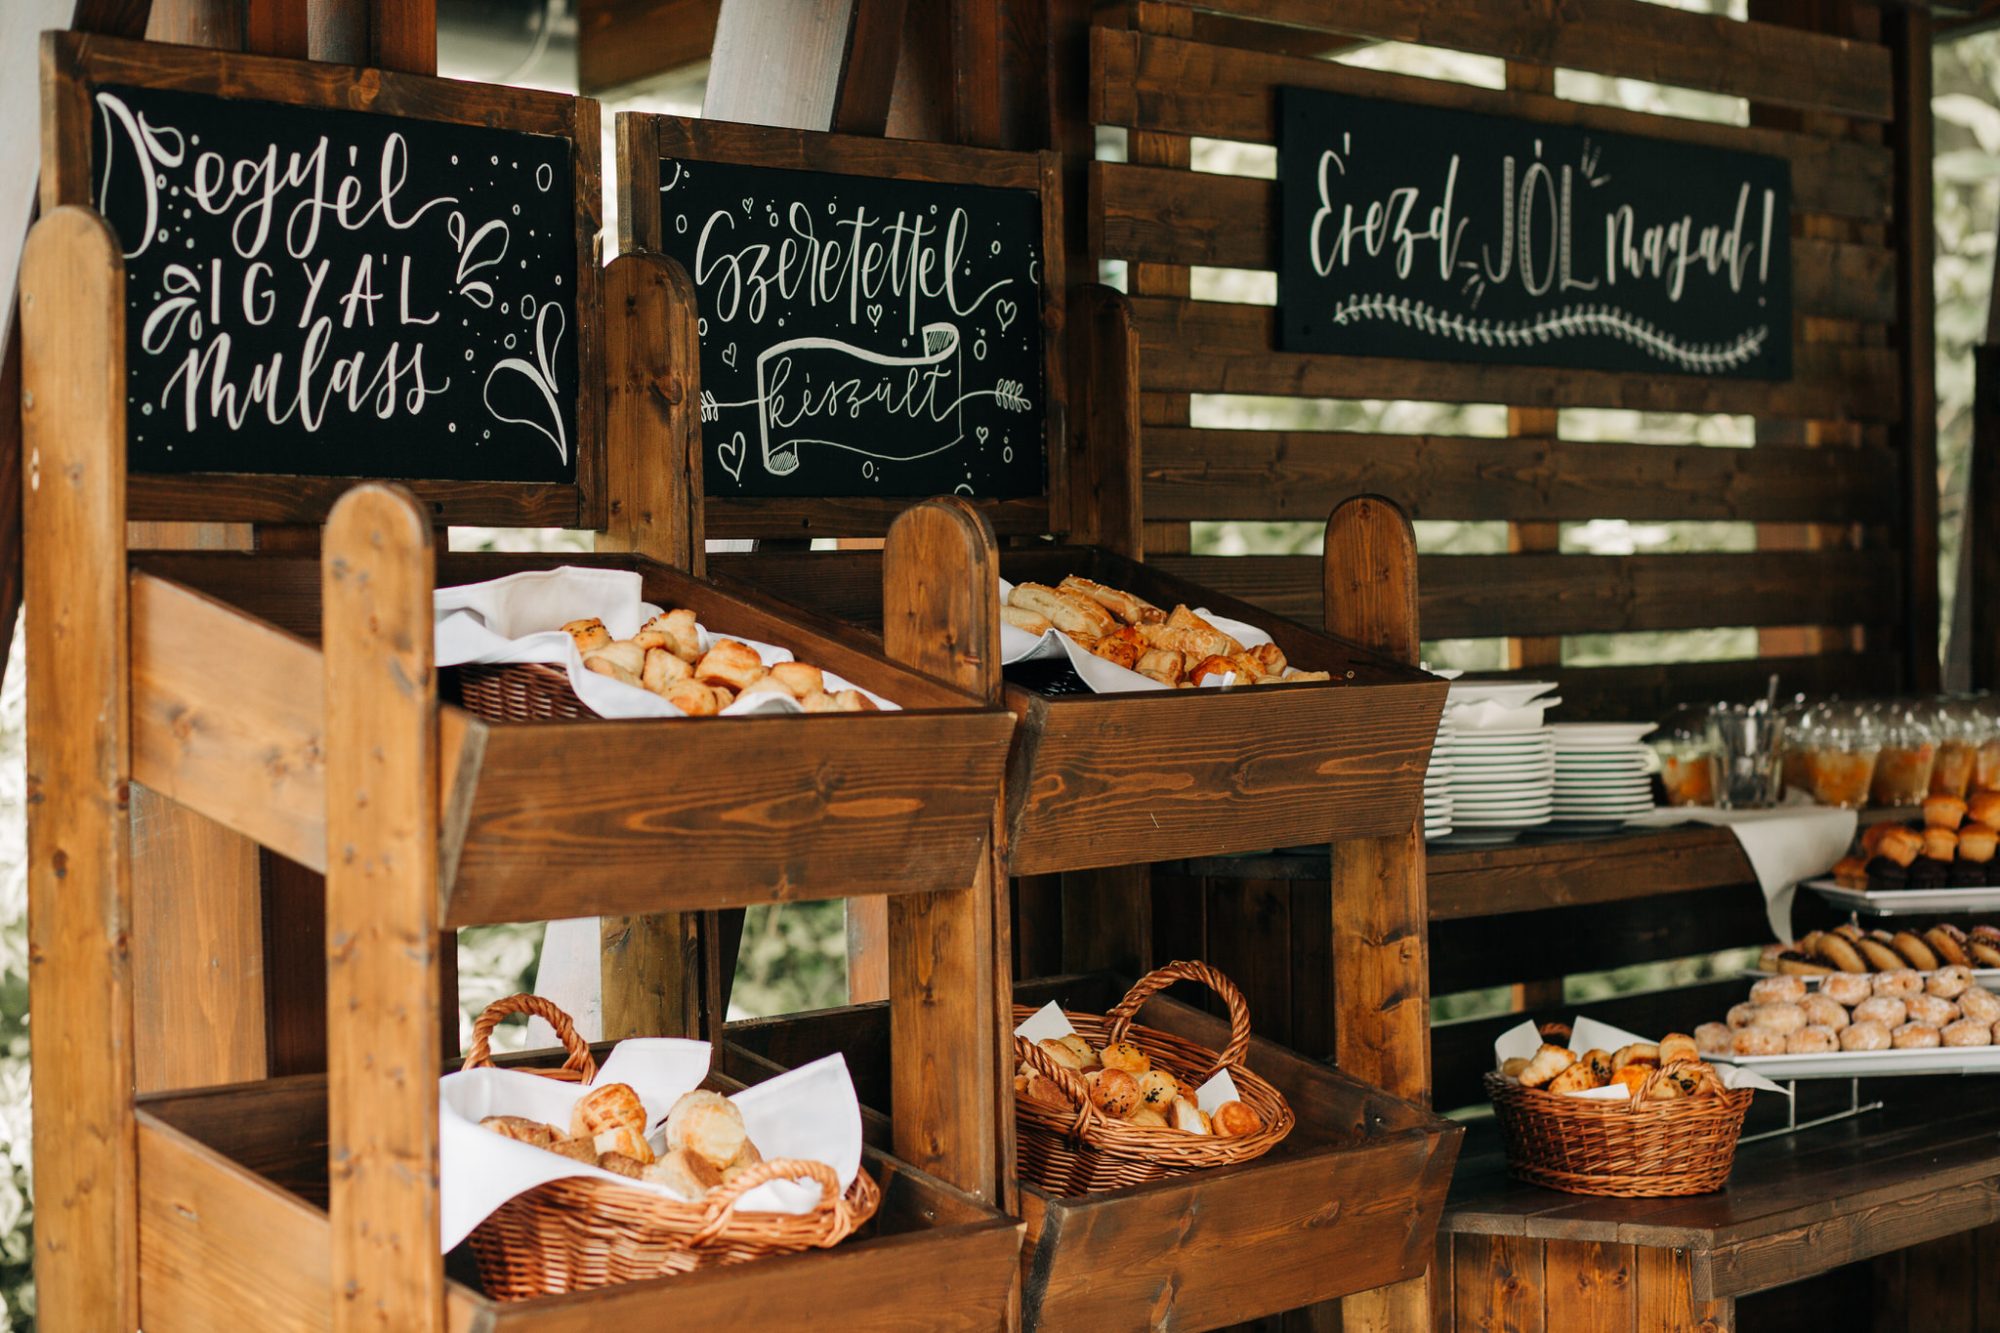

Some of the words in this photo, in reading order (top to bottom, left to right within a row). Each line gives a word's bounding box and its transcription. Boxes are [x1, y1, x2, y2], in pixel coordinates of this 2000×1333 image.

[1310, 132, 1470, 281] Érezd
[1482, 139, 1599, 296] JÓL
[210, 253, 440, 329] IGYÁL
[695, 201, 1014, 335] Szeretettel
[768, 356, 955, 429] készült
